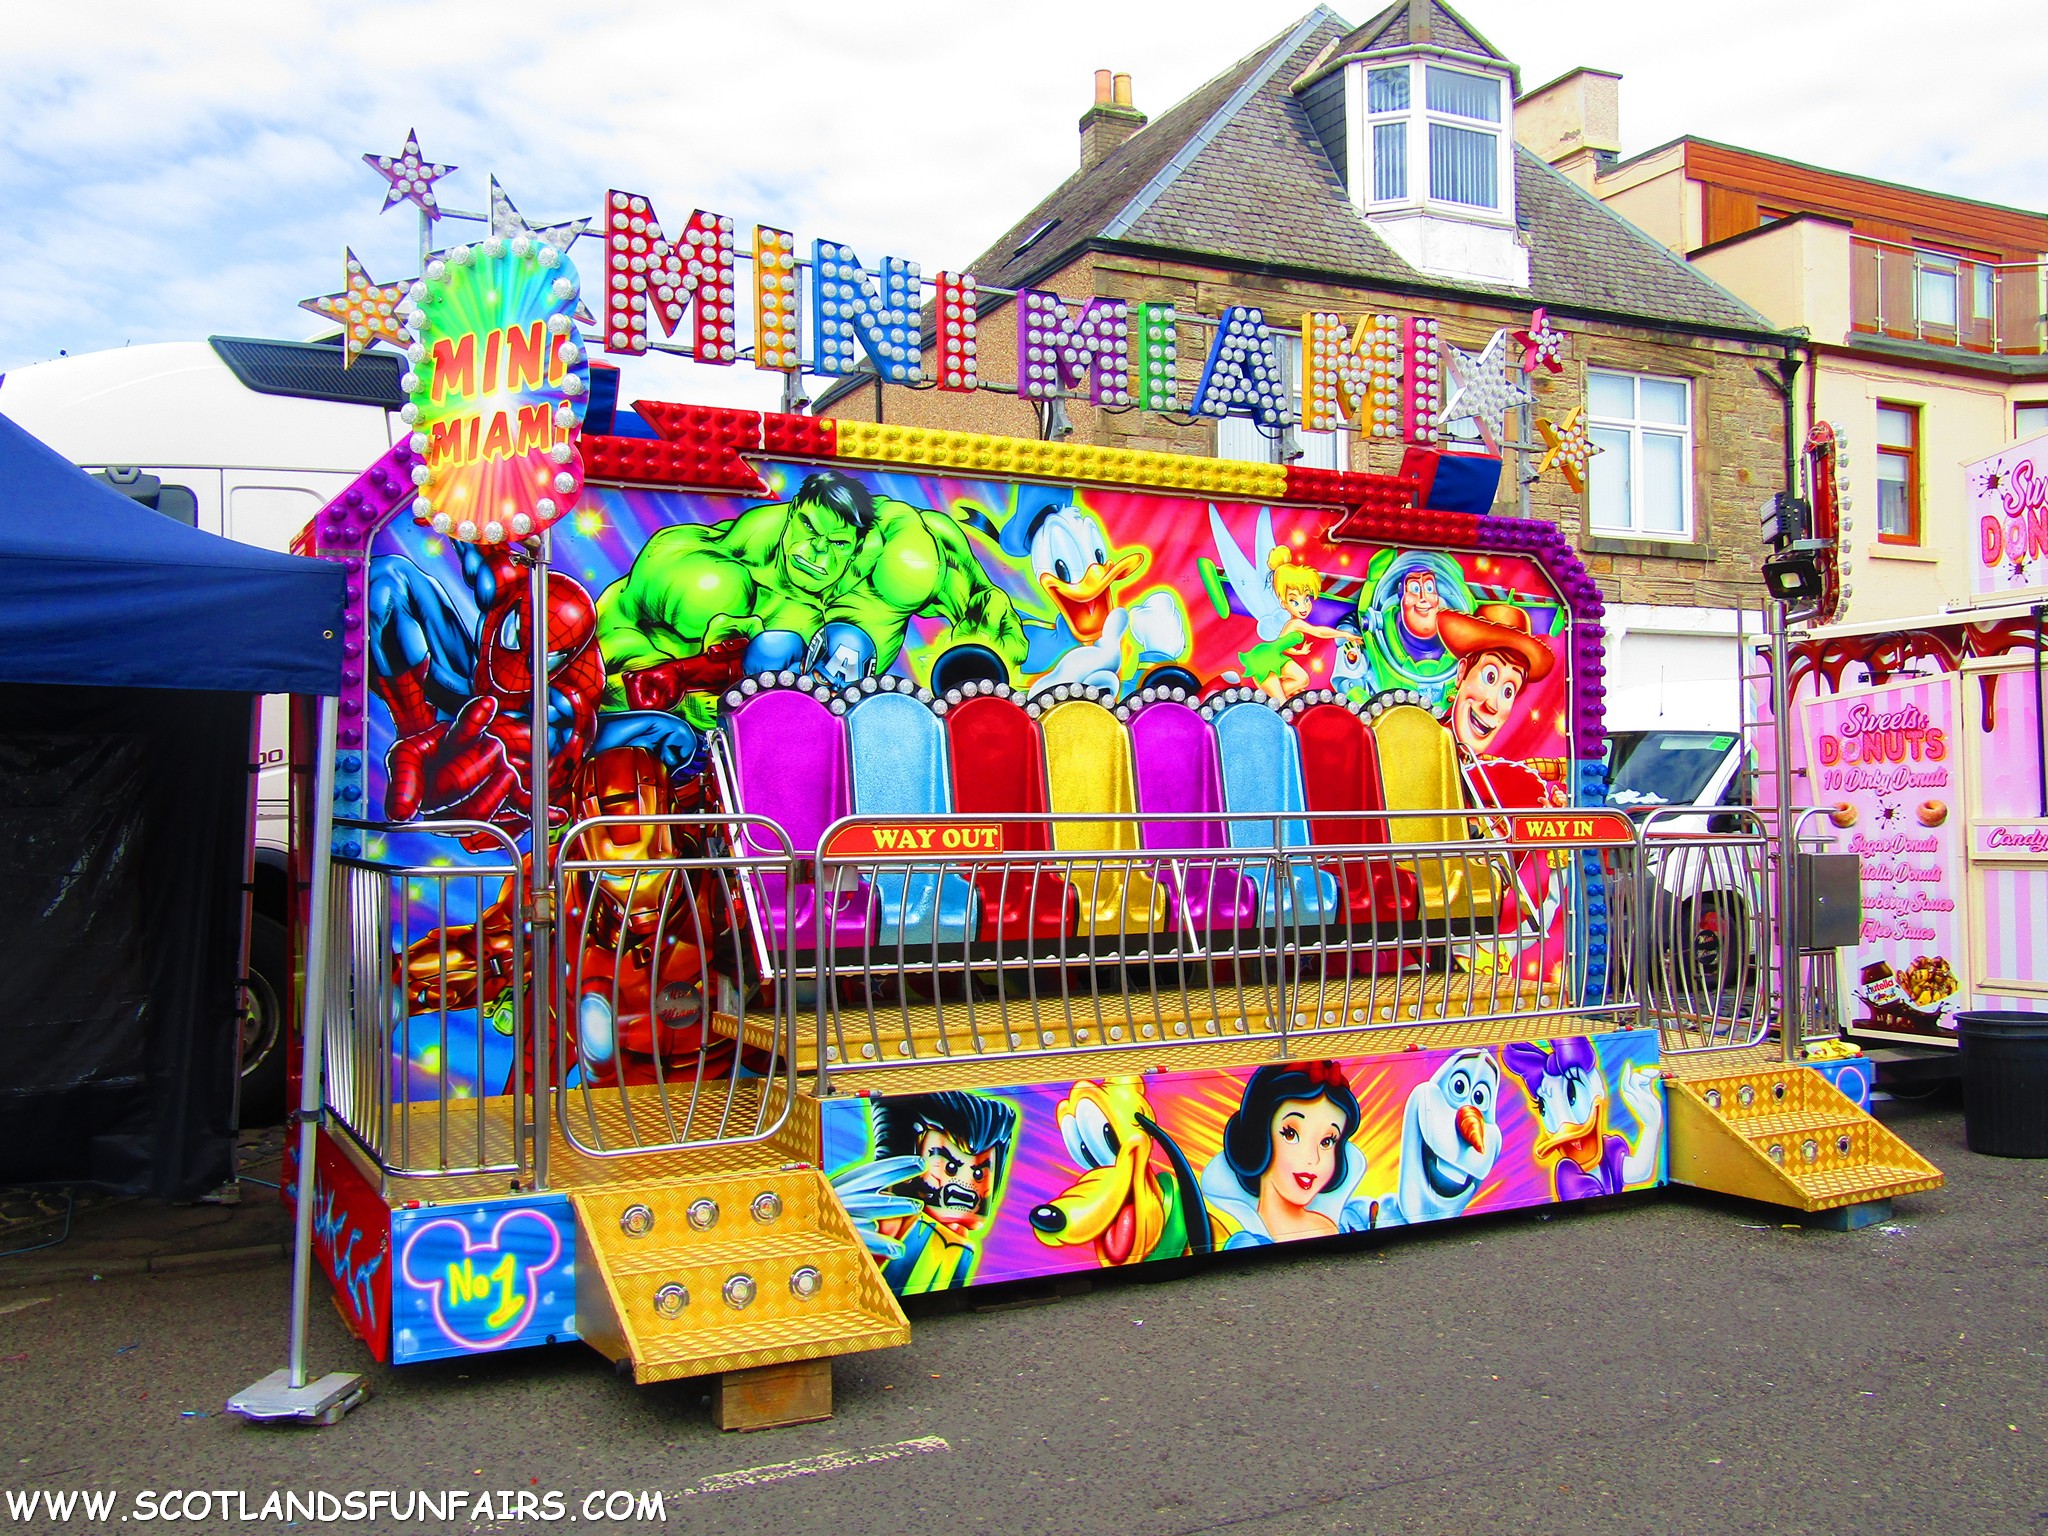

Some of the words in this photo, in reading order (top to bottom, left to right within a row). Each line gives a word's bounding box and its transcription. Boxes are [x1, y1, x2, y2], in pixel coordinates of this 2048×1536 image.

[604, 188, 977, 392] MINI
[1017, 287, 1440, 445] MIAMI
[430, 319, 572, 408] MINI
[1840, 703, 1921, 738] Sweets
[1819, 727, 1947, 767] DONUTS
[1824, 769, 1843, 791] 10
[1891, 765, 1949, 791] Donuts
[872, 829, 937, 849] WAY
[942, 828, 998, 848] OUT
[1526, 821, 1569, 837] WAY
[1573, 820, 1594, 837] IN
[1986, 826, 2048, 853] Candy
[1848, 833, 1891, 858] Sugar
[1891, 833, 1938, 854] Donuts
[1860, 863, 1894, 881] utella
[1894, 862, 1942, 883] Donuts
[1909, 891, 1955, 912] Sauce
[1892, 920, 1936, 941] Sauce
[1867, 978, 1894, 994] nutella
